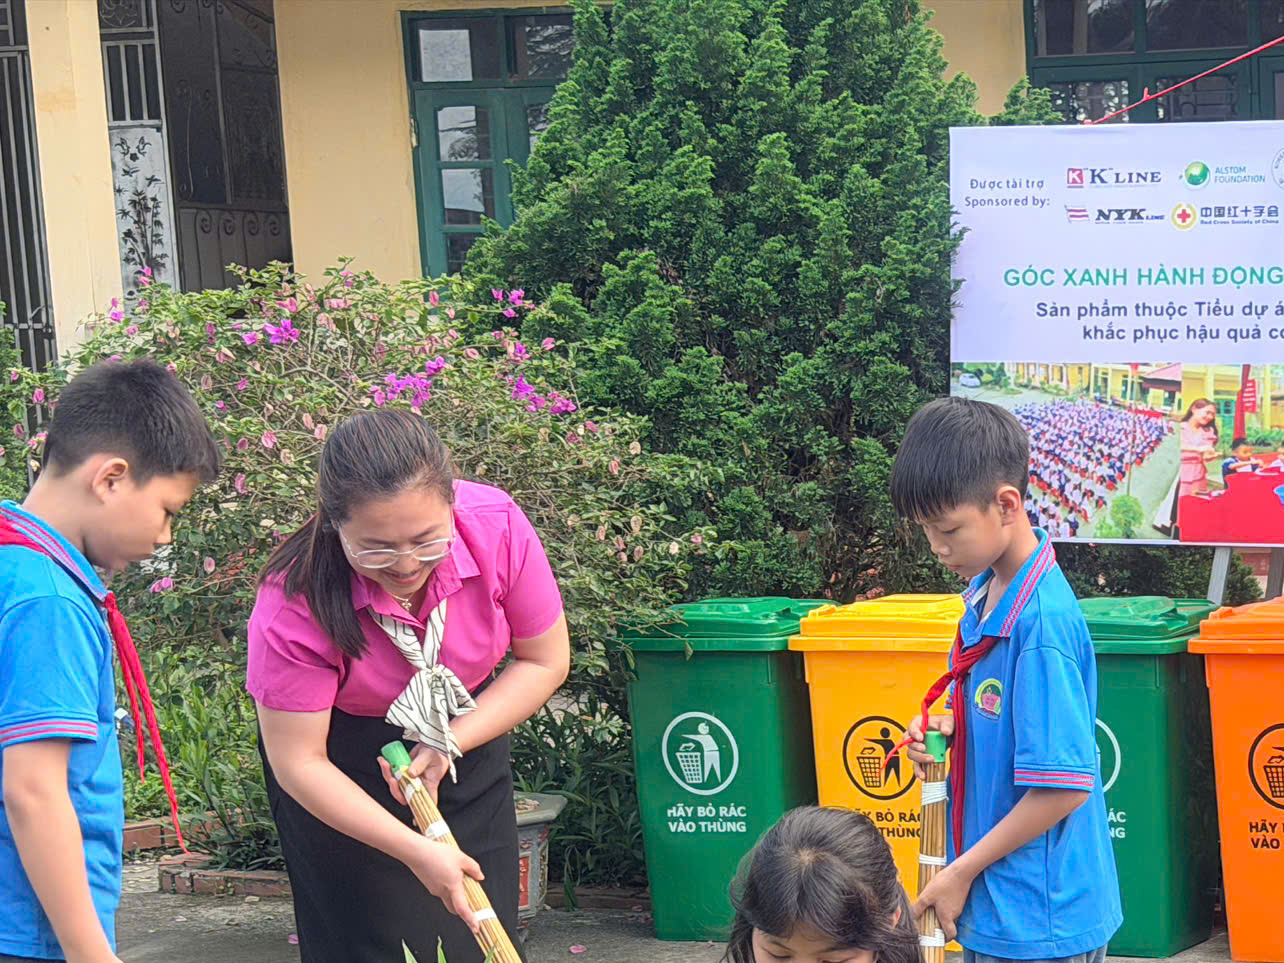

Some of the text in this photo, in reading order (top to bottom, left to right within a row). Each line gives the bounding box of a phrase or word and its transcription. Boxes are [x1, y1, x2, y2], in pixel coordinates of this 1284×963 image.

[1215, 166, 1246, 174] ALSTOM
[970, 178, 1044, 191] Được tài trợ
[1114, 172, 1162, 183] LINE
[1214, 175, 1266, 183] FOUNDATION
[964, 195, 1050, 208] Sponsored by:
[1095, 208, 1146, 221] NYK
[1200, 205, 1279, 218] 中国红十字会
[1004, 264, 1055, 287] GÓC
[1063, 268, 1128, 286] XANH
[1137, 264, 1204, 286] HÀNH
[1212, 265, 1284, 289] ĐỘNG
[1036, 301, 1070, 317] Sản
[1077, 299, 1128, 320] phẩm
[1135, 302, 1188, 320] thuộc
[1195, 298, 1234, 317] Tiểu
[1242, 301, 1269, 319] dự
[1083, 321, 1125, 340] khắc
[1133, 325, 1179, 343] phục
[1186, 324, 1220, 343] hậu
[1227, 323, 1261, 343] quả
[666, 802, 747, 817] HÃY BỎ RÁC
[875, 808, 895, 822] BỎ
[1107, 807, 1127, 823] ÁC
[667, 818, 747, 833] VÀO THÙNG
[1249, 819, 1278, 833] HÃY
[1250, 834, 1280, 849] VÀO
